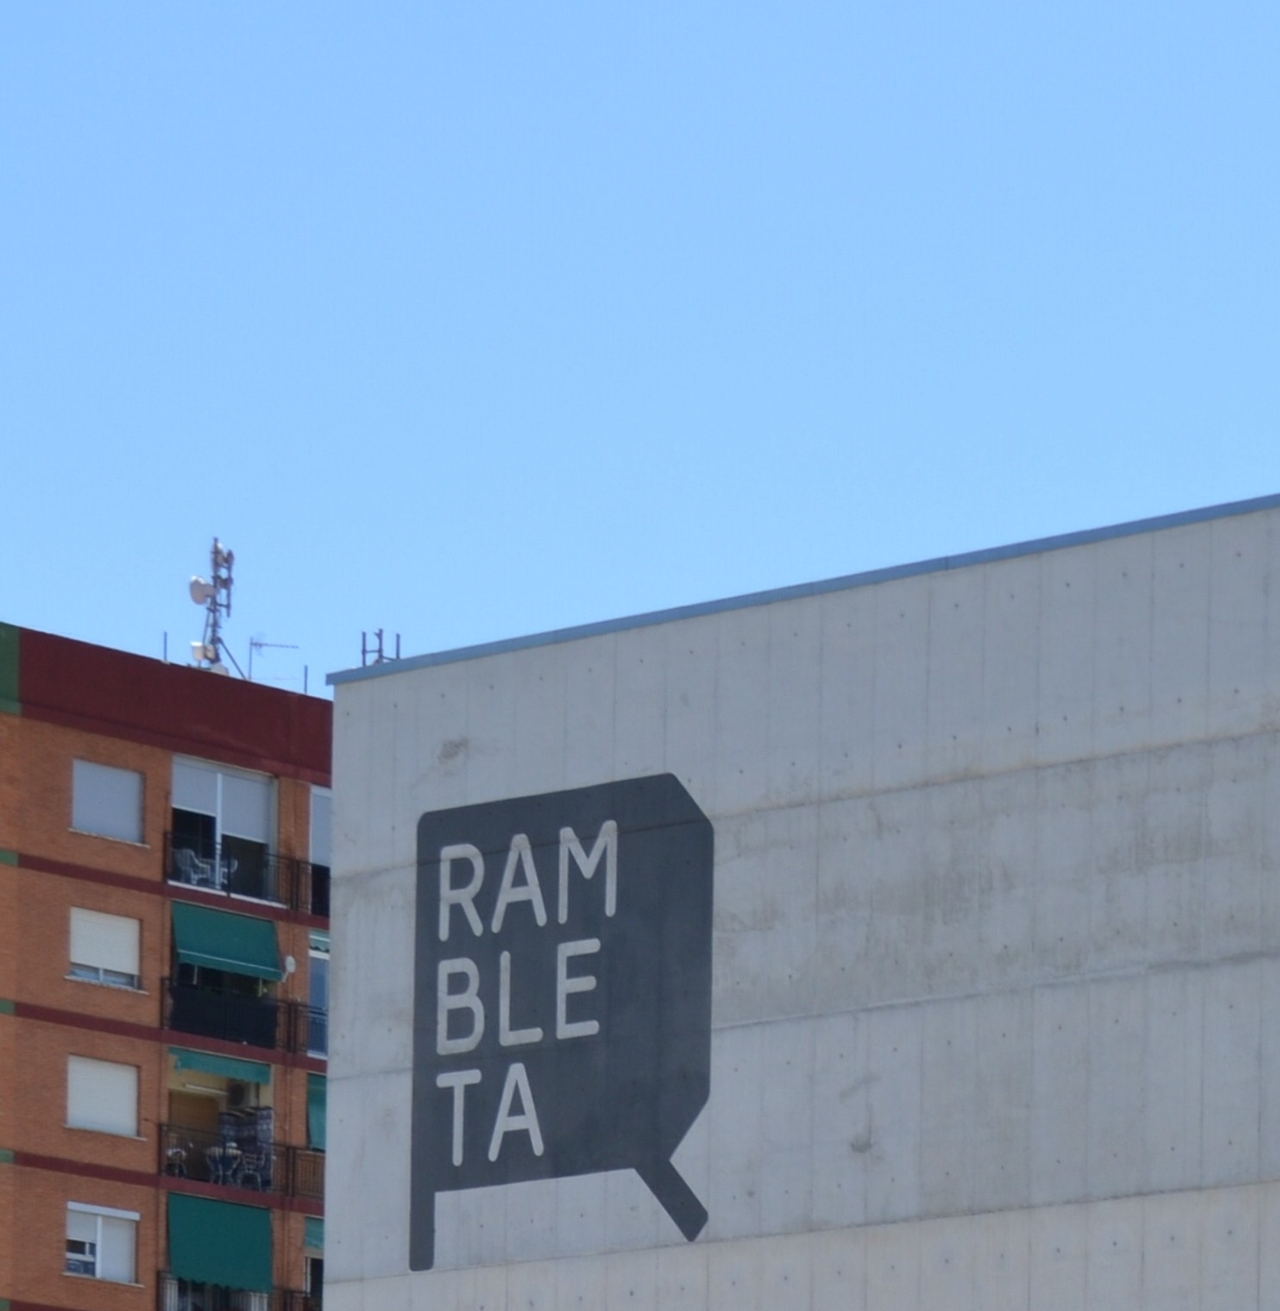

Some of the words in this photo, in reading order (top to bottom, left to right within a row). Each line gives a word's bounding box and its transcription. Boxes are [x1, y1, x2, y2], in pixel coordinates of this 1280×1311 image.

[439, 820, 617, 942] RAM
[436, 938, 601, 1056] BLE
[436, 1062, 545, 1167] TA
